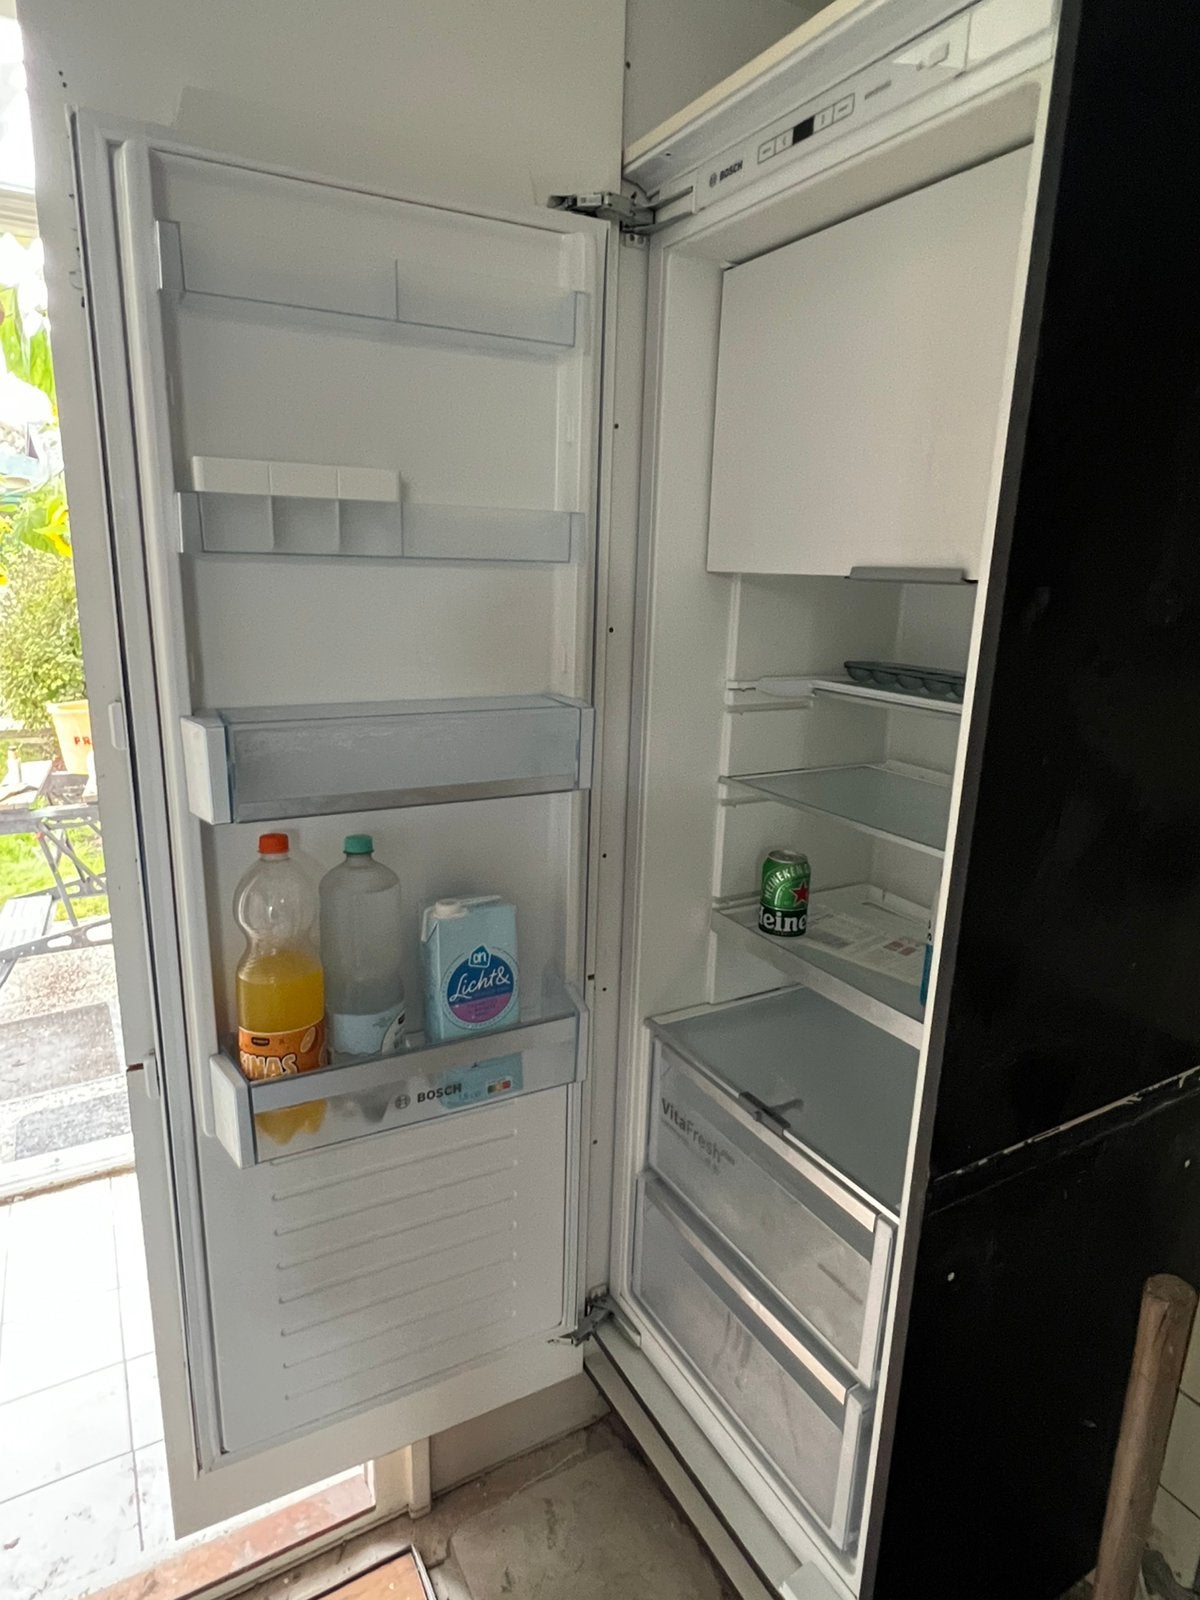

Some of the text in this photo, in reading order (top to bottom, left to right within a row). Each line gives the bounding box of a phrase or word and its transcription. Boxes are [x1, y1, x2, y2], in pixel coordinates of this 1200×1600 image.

[719, 160, 743, 181] BOSCH
[417, 1083, 462, 1103] BOSCH
[661, 1097, 721, 1164] VitaFresh
